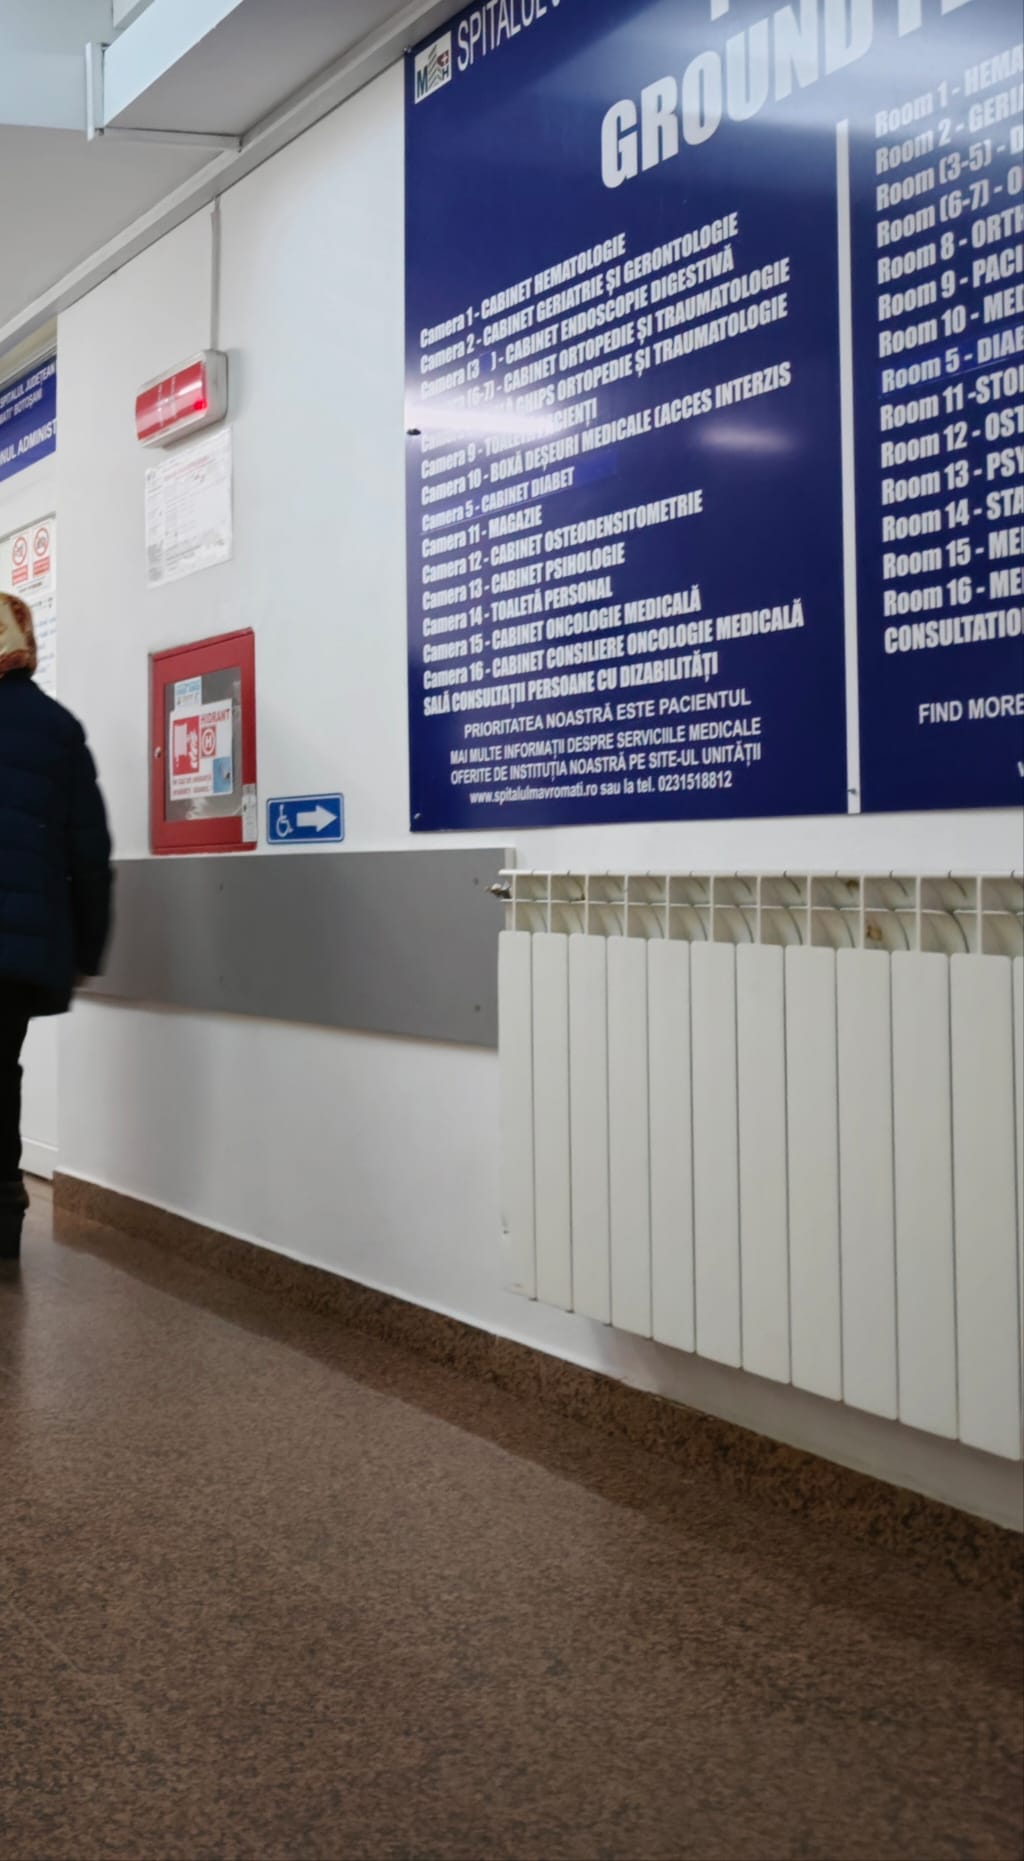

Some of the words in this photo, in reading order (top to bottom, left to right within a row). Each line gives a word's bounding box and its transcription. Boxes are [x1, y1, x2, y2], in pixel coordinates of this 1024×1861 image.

[601, 0, 874, 189] GROUND
[875, 92, 933, 139] Room
[937, 79, 948, 108] 1
[876, 129, 934, 175] Room
[938, 117, 951, 147] 2
[878, 242, 936, 285] Room
[940, 231, 954, 261] 8
[420, 313, 465, 348] Camera
[466, 306, 473, 326] 1
[481, 277, 532, 320] CABINET
[534, 232, 626, 295] HEMATOLOGIE
[420, 341, 465, 374] Camera
[466, 333, 475, 354] 2
[483, 305, 535, 346] CABINET
[536, 273, 604, 323] GERIATRIE
[623, 211, 739, 283] GERONTOLOGIE
[878, 280, 937, 322] Room
[941, 270, 955, 299] 9
[420, 368, 465, 400] Camera
[505, 324, 559, 365] CABINET
[561, 285, 648, 342] ENDOSCOPIE
[650, 243, 734, 304] DIGESTIVĂ
[503, 353, 557, 393] CABINET
[559, 321, 635, 371] ORTOPEDIE
[655, 257, 790, 333] TRAUMATOLOGIE
[557, 353, 633, 402] ORTOPEDIE
[653, 292, 788, 365] TRAUMATOLOGIE
[421, 476, 466, 506] Camera
[467, 467, 482, 490] 10
[490, 451, 523, 483] BOXĂ
[524, 433, 579, 472] DEȘEURI
[581, 409, 651, 452] MEDICALE
[654, 388, 712, 428] (ACCES
[715, 361, 792, 408] INTERZIS
[422, 504, 465, 532] Camera
[465, 499, 474, 518] 5
[481, 481, 529, 513] CABINET
[531, 466, 575, 498] DIABET
[881, 470, 940, 506] Room
[944, 458, 969, 491] 13
[422, 529, 466, 558] Camera
[468, 523, 480, 545] 11
[488, 504, 543, 539] MAGAZIE
[422, 557, 467, 585] Camera
[468, 550, 482, 572] 12
[491, 533, 543, 566] CABINET
[545, 489, 703, 552] OSTEODENSITOMETRIE
[423, 611, 467, 637] Camera
[469, 605, 483, 626] 14
[491, 588, 543, 622] TOALETĂ
[544, 575, 613, 611] PERSONAL
[423, 638, 467, 664] Camera
[469, 633, 483, 653] 15
[492, 620, 544, 650] CABINET
[546, 604, 622, 640] ONCOLOGIE
[624, 584, 702, 625] MEDICALĂ
[884, 606, 1024, 655] CONSULTATIO
[423, 665, 468, 690] Camera
[469, 660, 484, 681] 16
[492, 649, 544, 678] CABINET
[546, 634, 625, 670] CONSILIERE
[627, 618, 713, 655] ONCOLOGIE
[716, 597, 805, 641] MEDICALĂ
[423, 690, 450, 717] SALĂ
[452, 681, 526, 712] CONSULTAȚII
[527, 670, 594, 702] PERSOANE
[597, 666, 618, 692] CU
[619, 649, 719, 688] DIZABILITĂȚI
[464, 714, 544, 739] PRIORITATEA
[546, 702, 614, 729] NOASTRĂ
[616, 700, 655, 721] ESTE
[659, 688, 752, 716] PACIENTUL
[918, 700, 963, 725] FIND
[968, 693, 1024, 720] MORE
[201, 708, 231, 725] HIDRANT
[450, 749, 468, 765] MAI
[469, 745, 502, 763] MULTE
[504, 738, 565, 760] INFORMAȚII
[567, 732, 614, 752] DESPRE
[617, 725, 686, 748] SERVICIILE
[689, 717, 761, 742] MEDICALE
[451, 766, 492, 785] OFERITE
[494, 765, 508, 782] DE
[510, 759, 567, 782] INSTITUȚIA
[569, 752, 626, 775] NOASTRĂ
[629, 753, 646, 771] PE
[648, 749, 699, 769] SITE-UL
[702, 740, 761, 767] UNITĂȚII
[469, 780, 598, 805] www.spitalulmavromati.ro
[600, 780, 621, 796] sau
[623, 778, 634, 794] la
[636, 776, 655, 794] tel.
[658, 770, 733, 792] 0231518812
